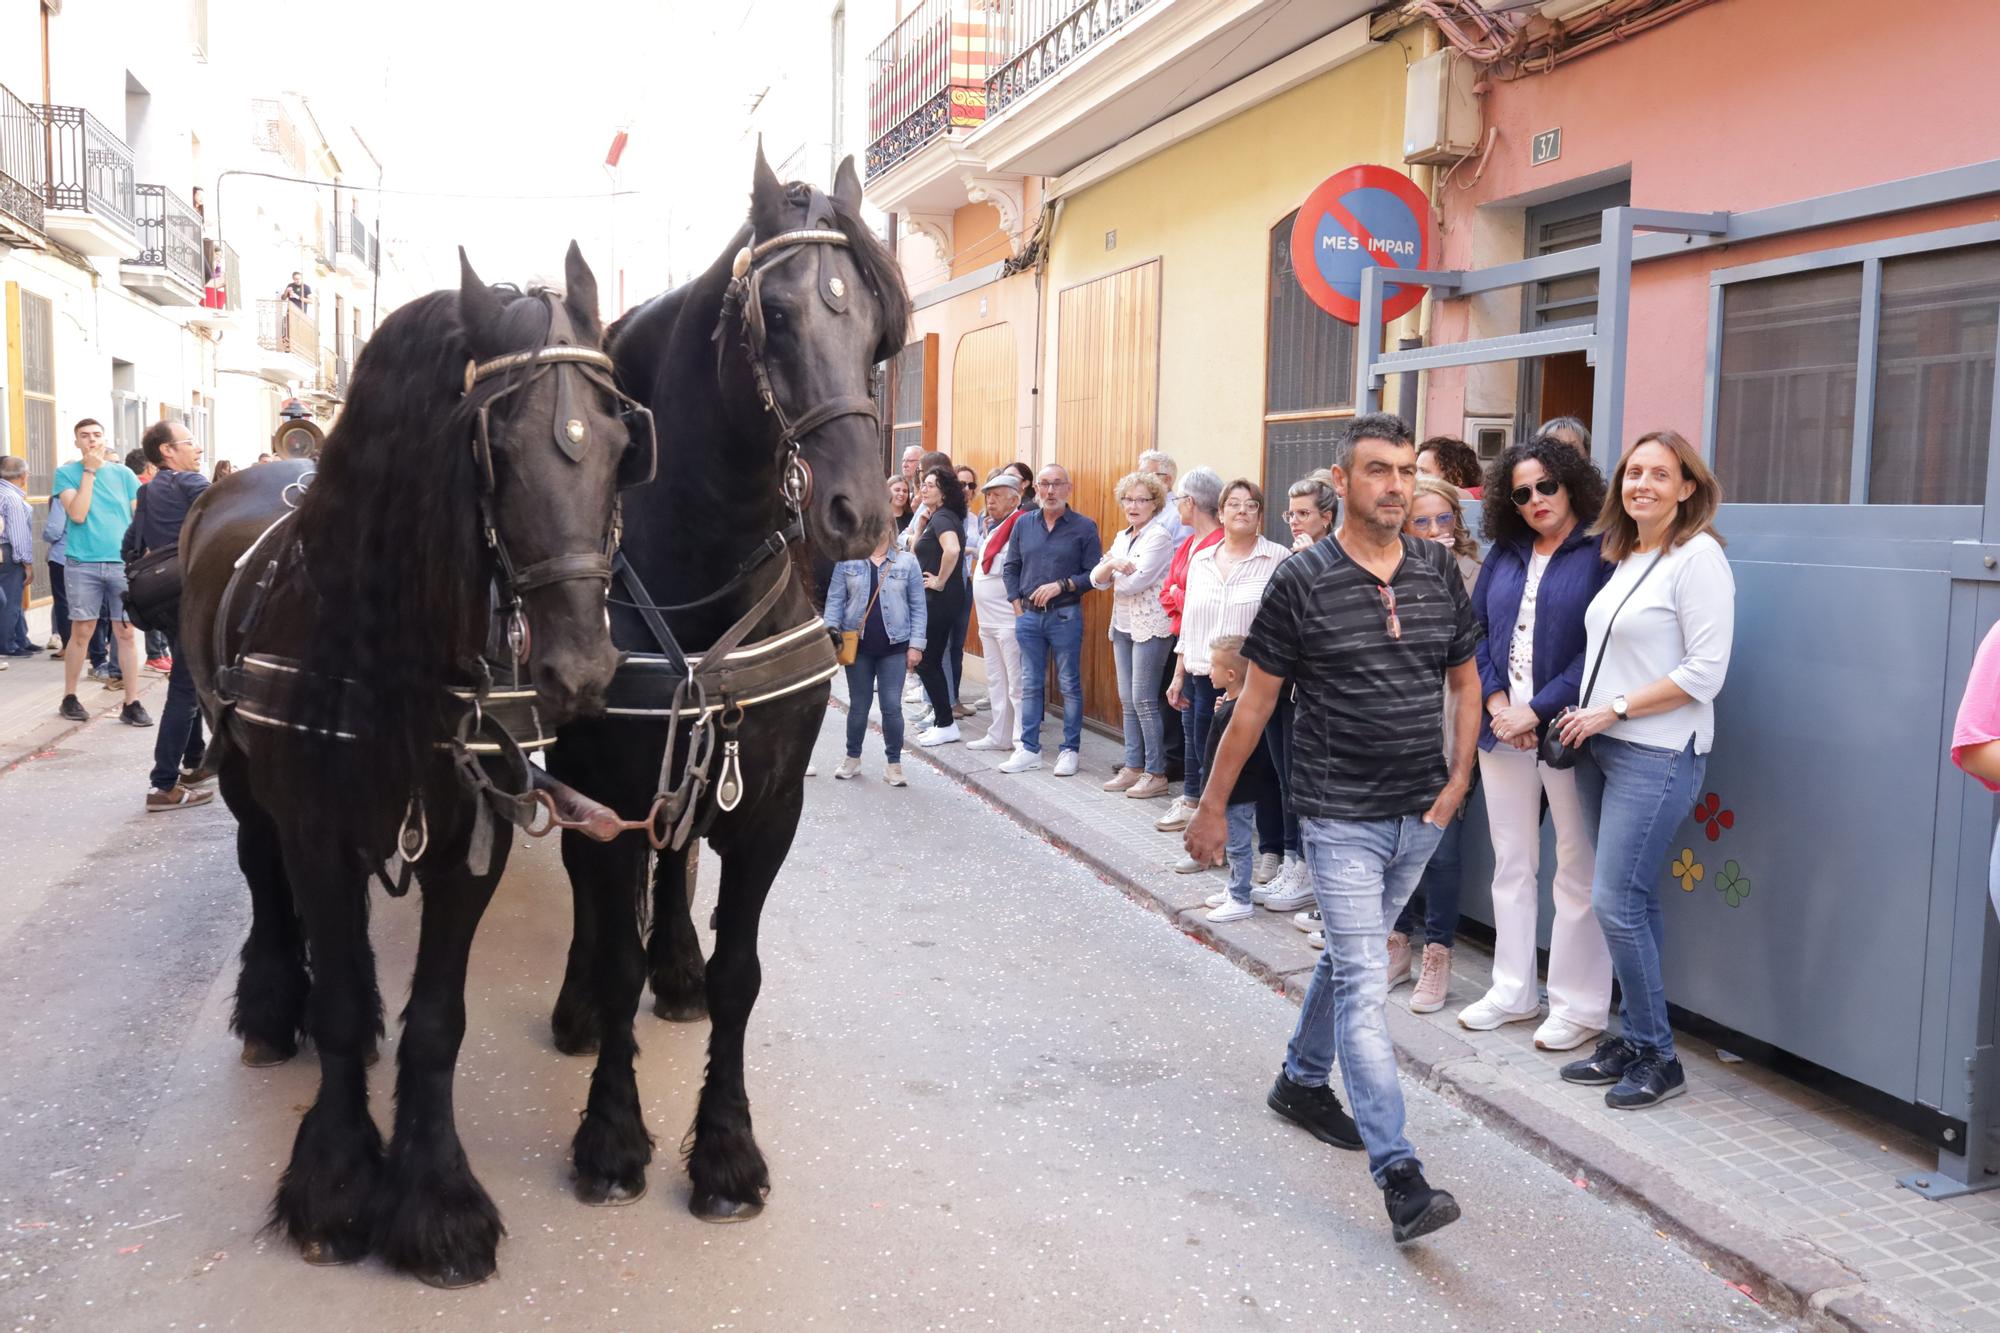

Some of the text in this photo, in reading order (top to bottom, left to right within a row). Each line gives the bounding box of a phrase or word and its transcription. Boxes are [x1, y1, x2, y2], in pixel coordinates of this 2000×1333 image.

[1538, 133, 1554, 160] 37
[1322, 235, 1415, 254] MES IMPAR
